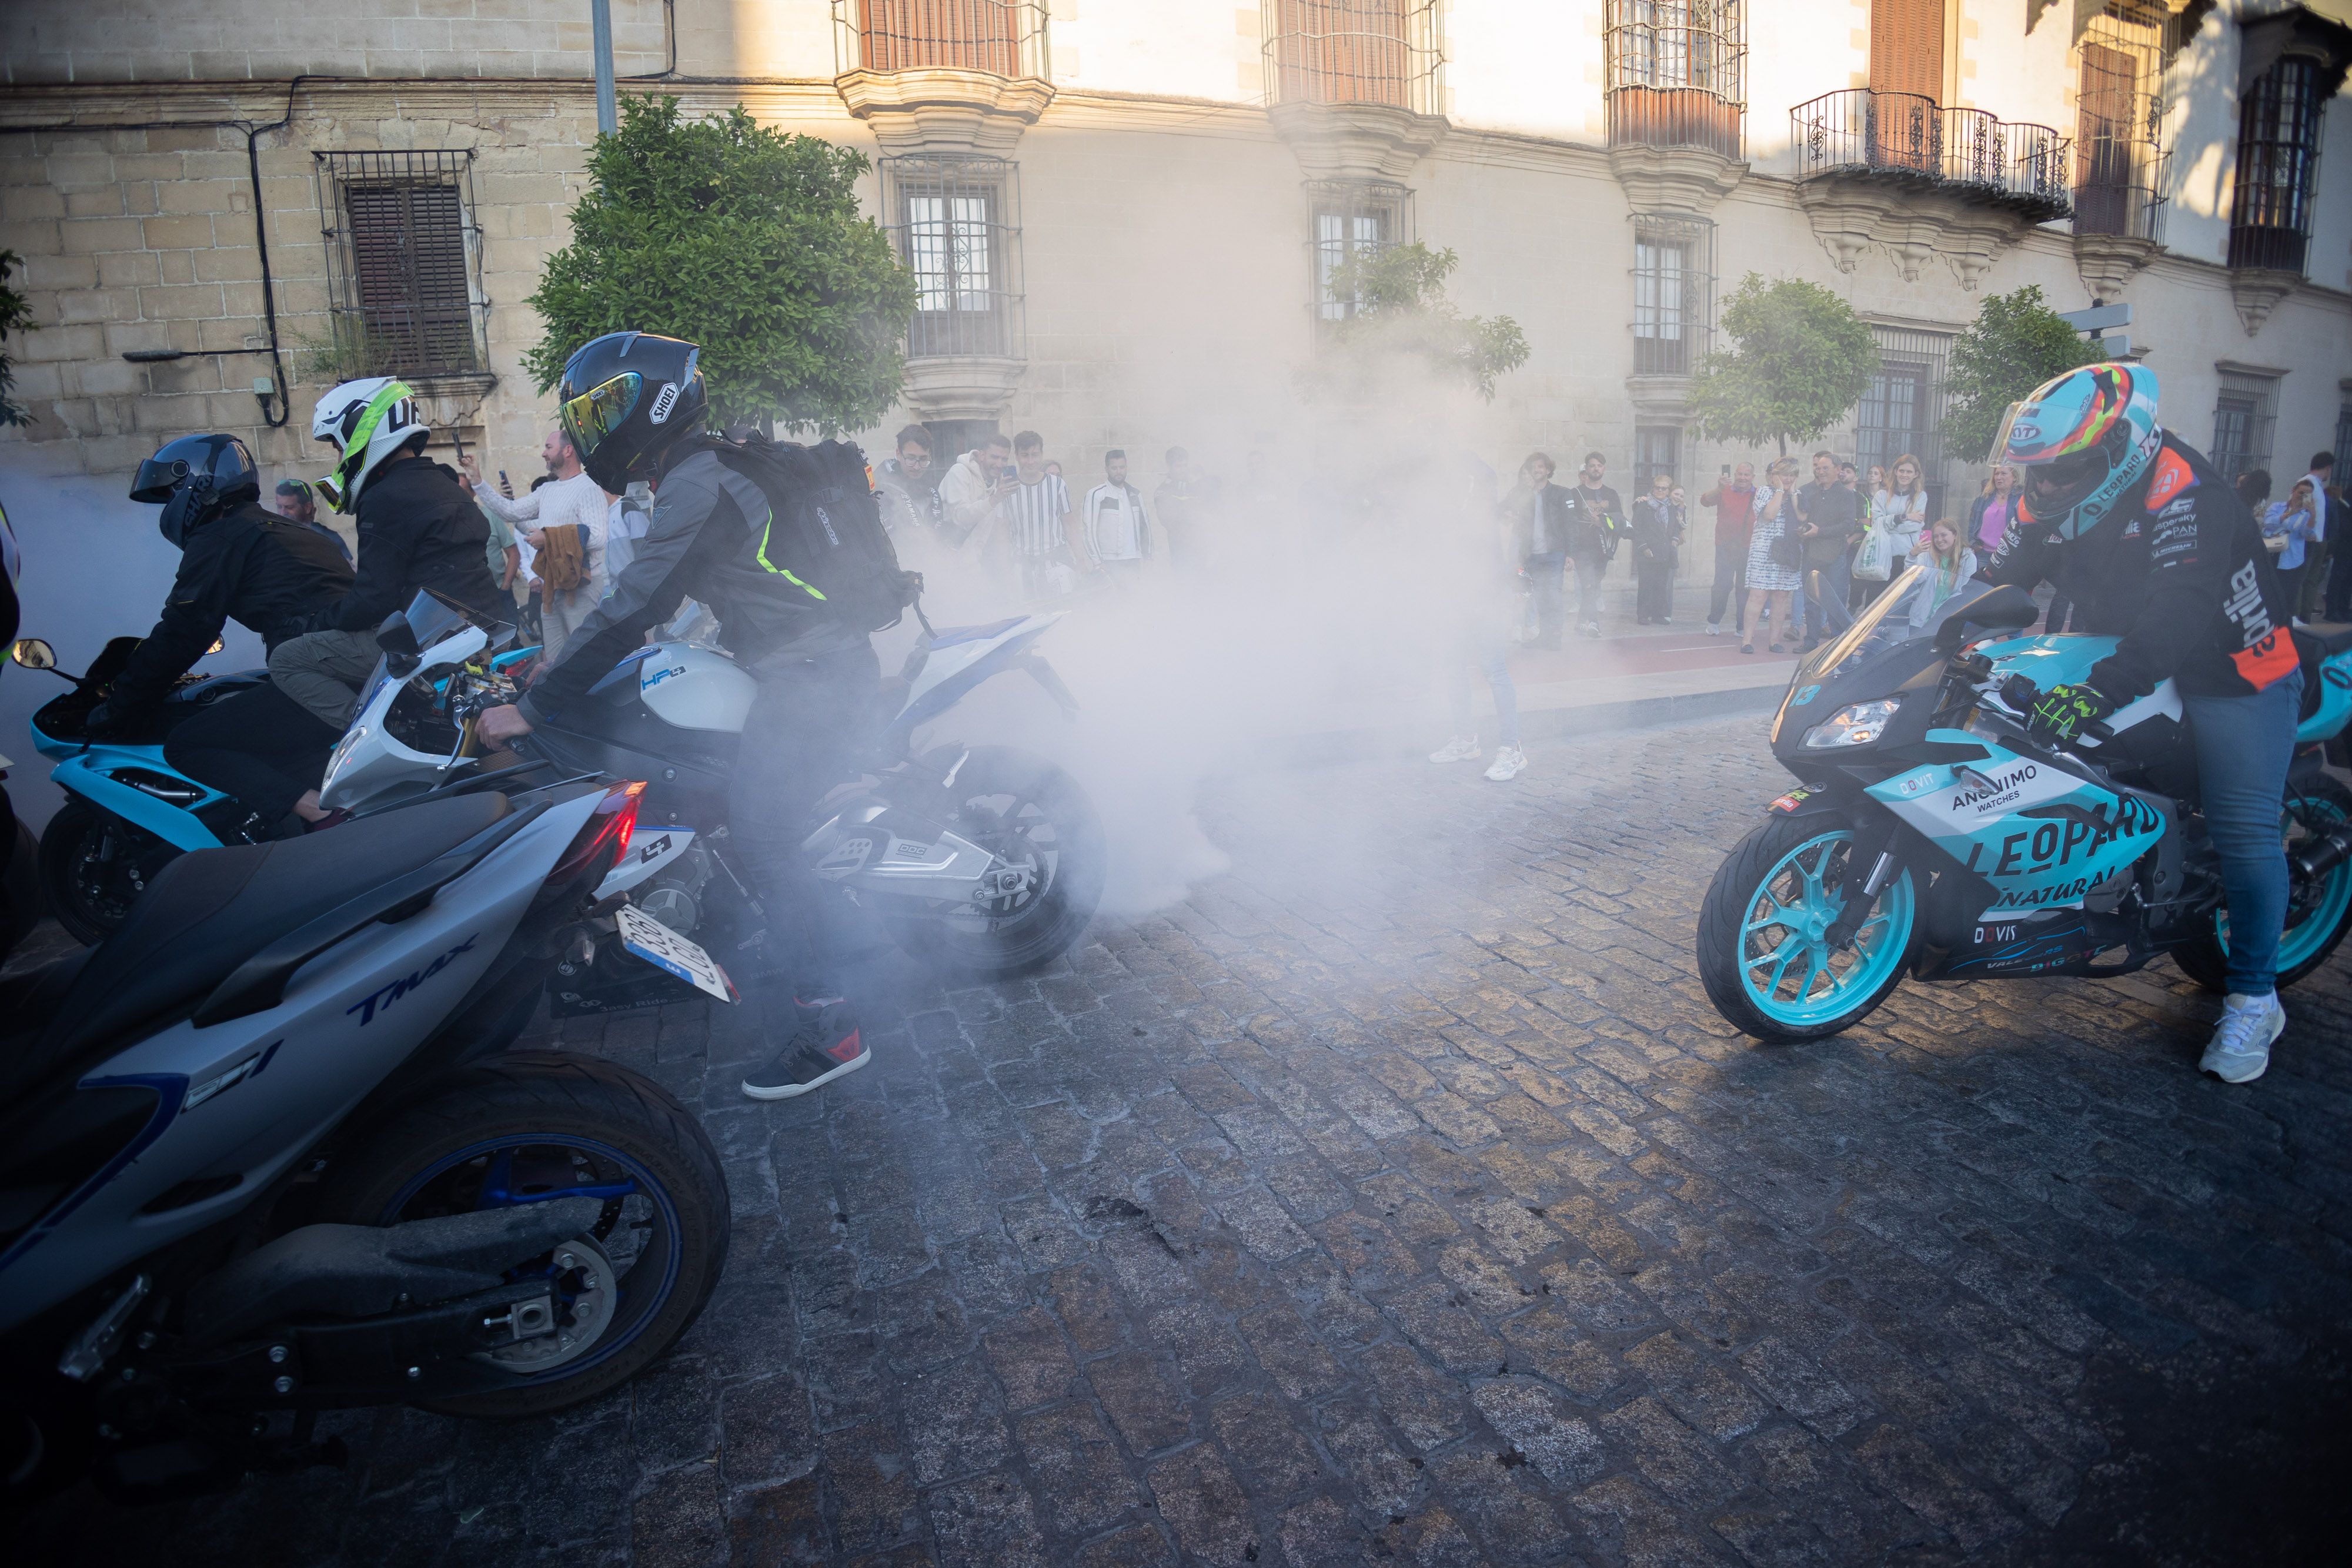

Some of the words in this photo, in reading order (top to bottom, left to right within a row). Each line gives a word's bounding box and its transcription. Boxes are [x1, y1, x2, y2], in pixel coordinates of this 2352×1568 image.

[654, 387, 676, 419] SHOEI
[2097, 453, 2140, 502] LEOPARD
[906, 496, 921, 527] YAMAHA
[2173, 524, 2197, 536] PAN
[2160, 543, 2192, 554] MICHELIN
[641, 666, 686, 690] HP4
[1789, 684, 1821, 707] 13
[1899, 773, 1934, 794] DOVIT
[1977, 791, 2020, 813] WATCHES
[1965, 793, 2159, 877] LEOPARD
[899, 845, 925, 854] DDC
[346, 932, 480, 1027] TMAX
[666, 962, 681, 974] E
